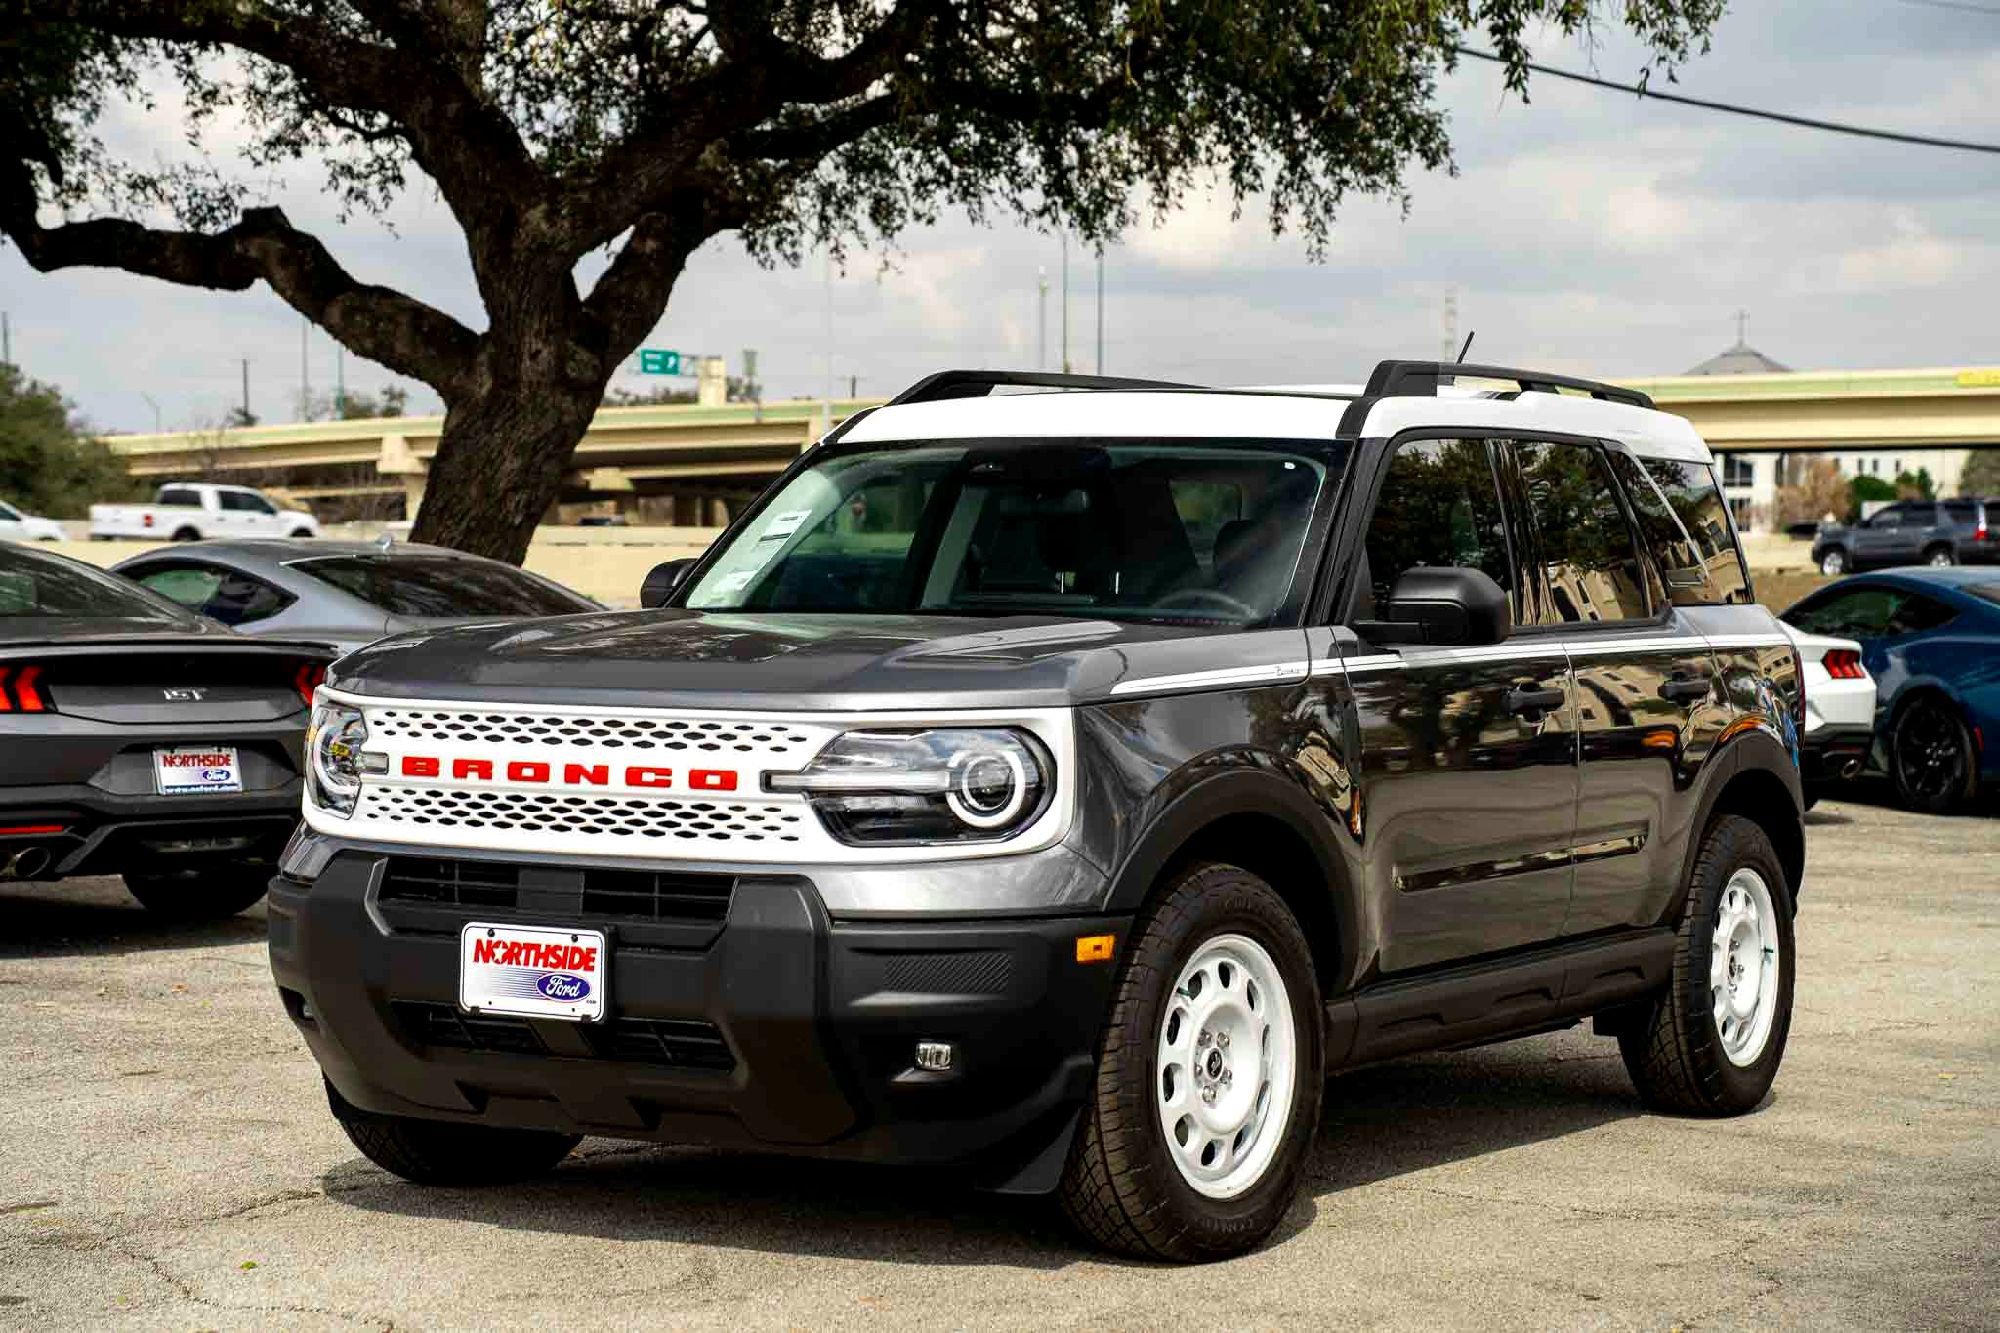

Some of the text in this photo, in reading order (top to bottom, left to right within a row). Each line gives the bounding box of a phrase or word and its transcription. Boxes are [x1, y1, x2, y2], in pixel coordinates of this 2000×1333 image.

[163, 754, 231, 768] NORTHSIDE
[402, 756, 737, 791] BRONCO
[473, 938, 597, 972] NORTHSIDE
[546, 975, 581, 998] Ford
